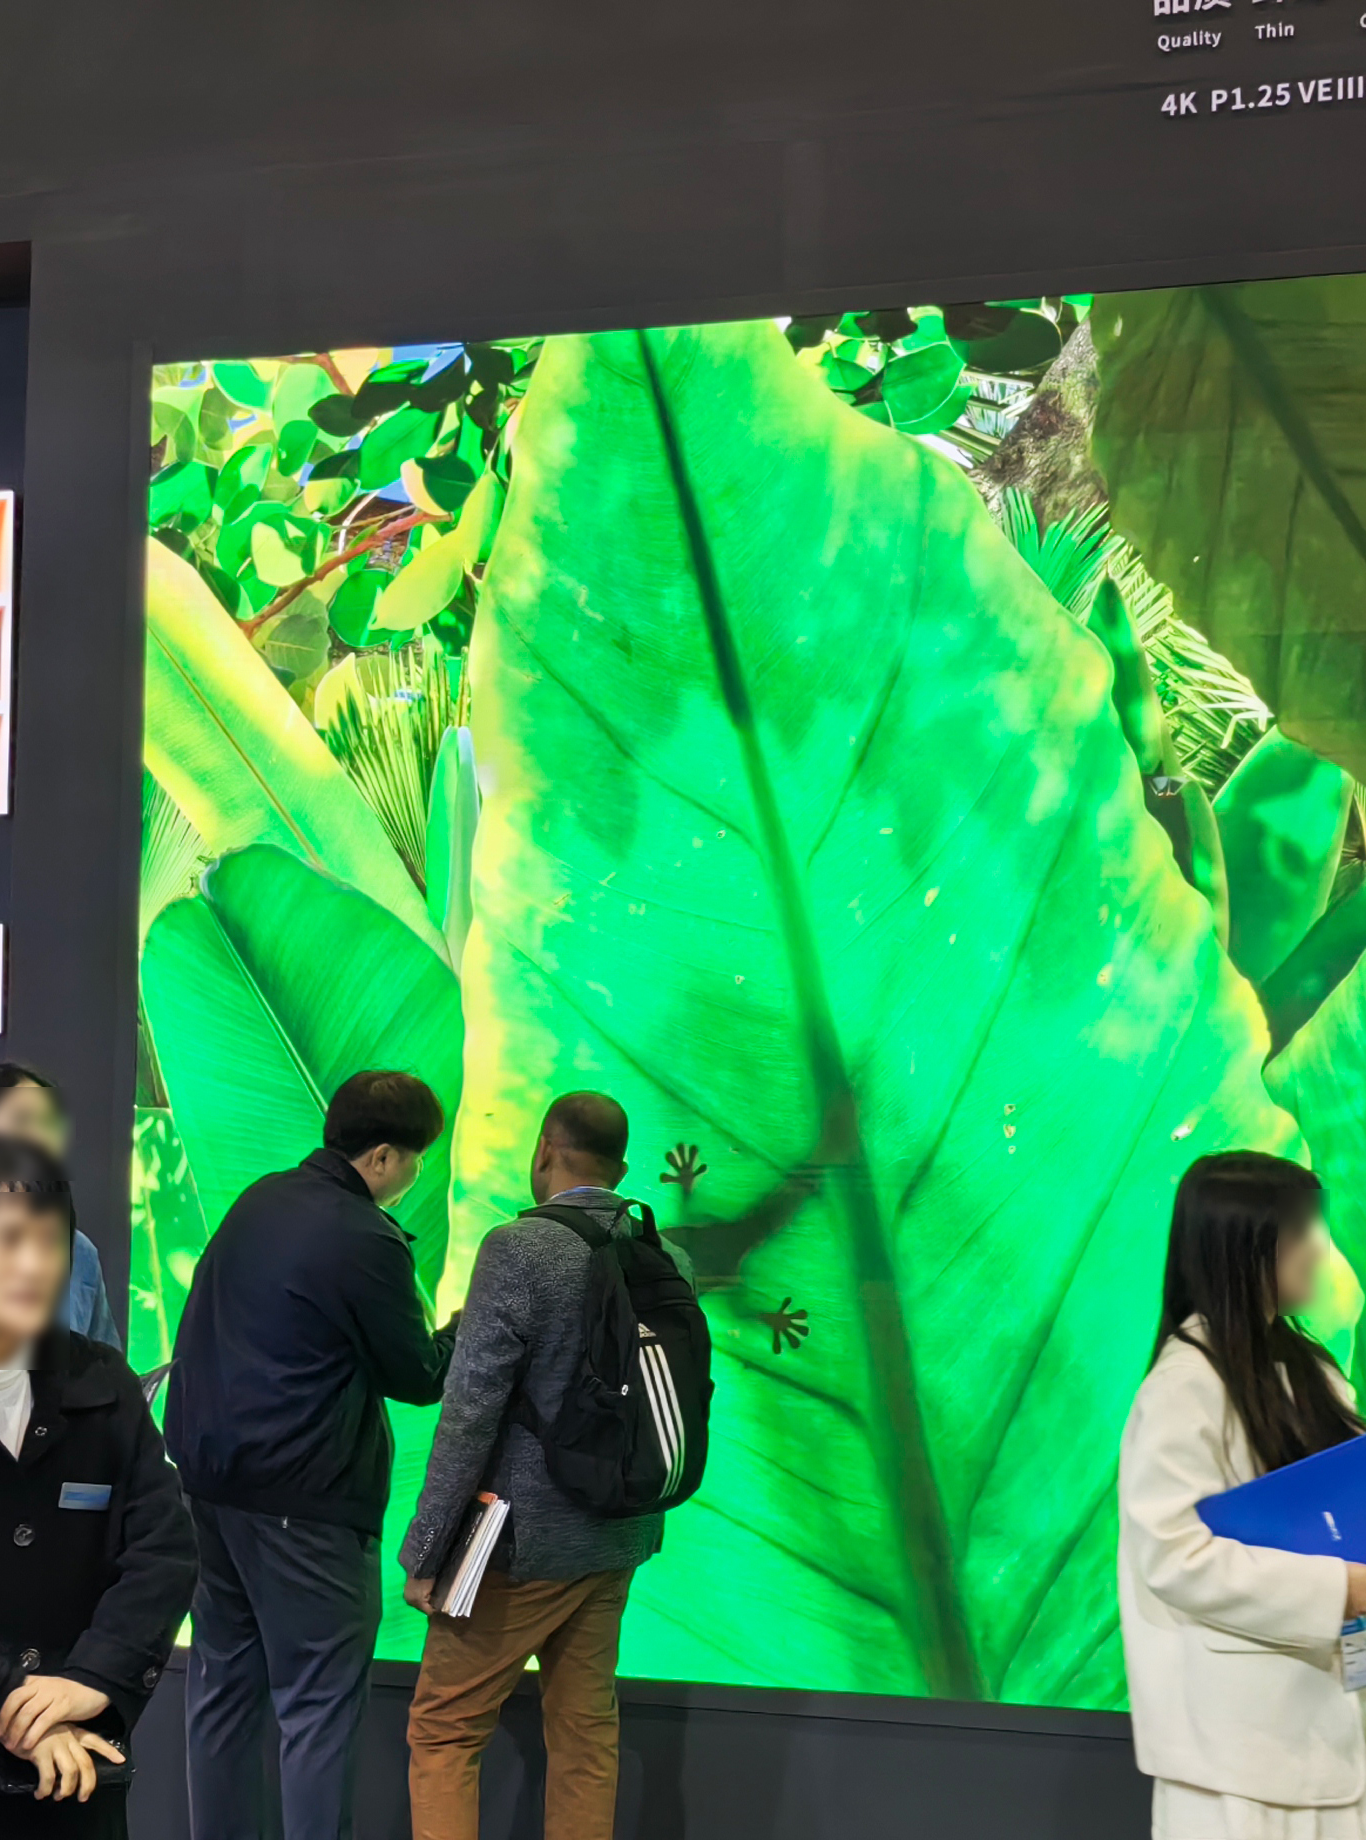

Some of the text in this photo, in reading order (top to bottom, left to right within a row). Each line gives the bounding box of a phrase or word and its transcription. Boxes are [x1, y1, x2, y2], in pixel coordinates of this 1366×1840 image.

[1157, 30, 1222, 52] Quality
[1254, 22, 1295, 40] Thin
[1160, 91, 1198, 116] 4K
[1211, 82, 1291, 112] P1.25
